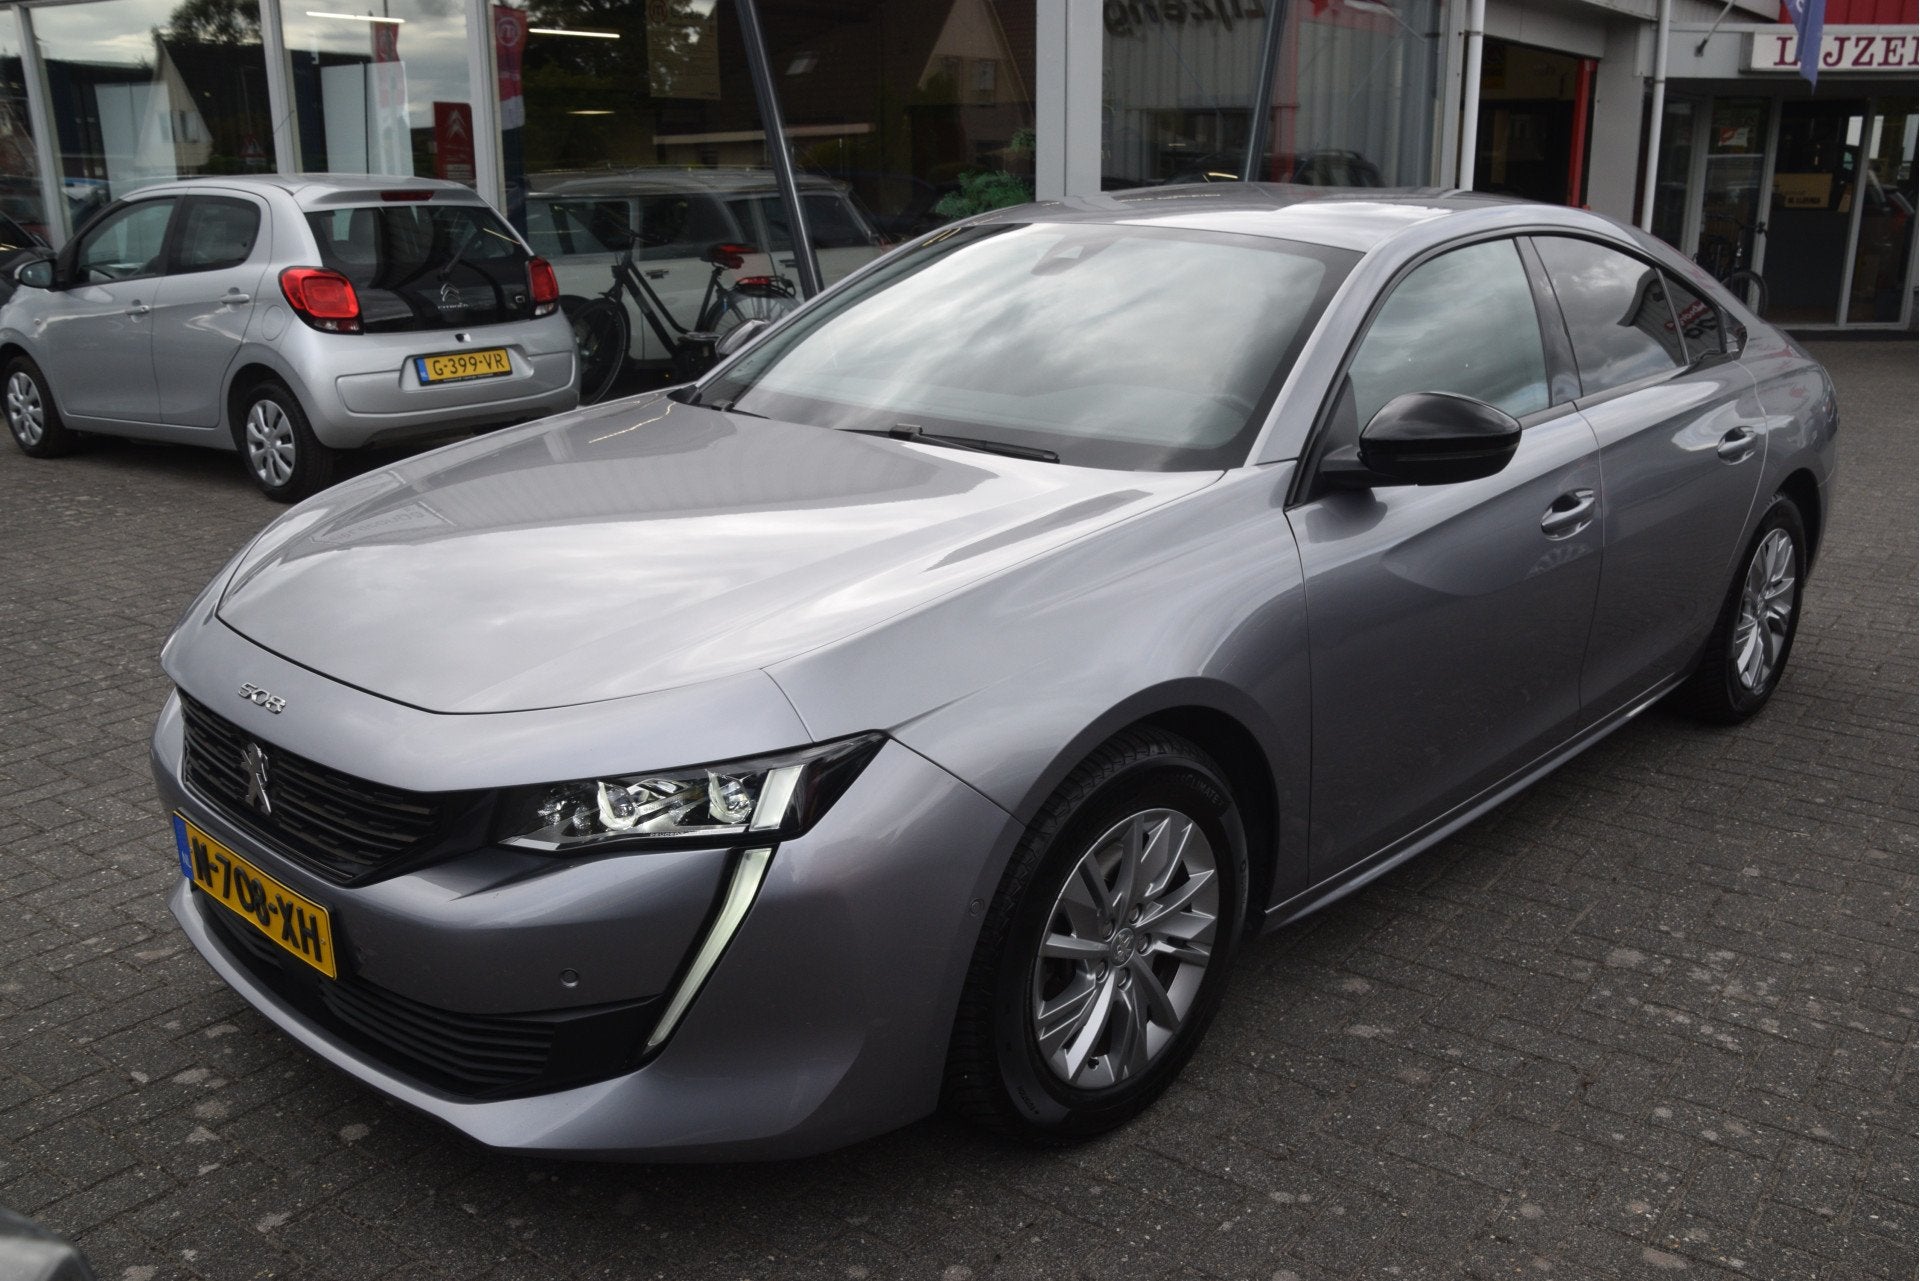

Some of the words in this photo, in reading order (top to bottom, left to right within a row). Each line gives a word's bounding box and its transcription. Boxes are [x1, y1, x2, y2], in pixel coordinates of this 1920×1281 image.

[1773, 36, 1920, 67] LJZE
[432, 353, 505, 376] G-399-VR
[238, 682, 287, 714] 508
[191, 835, 323, 963] N-708-XH
